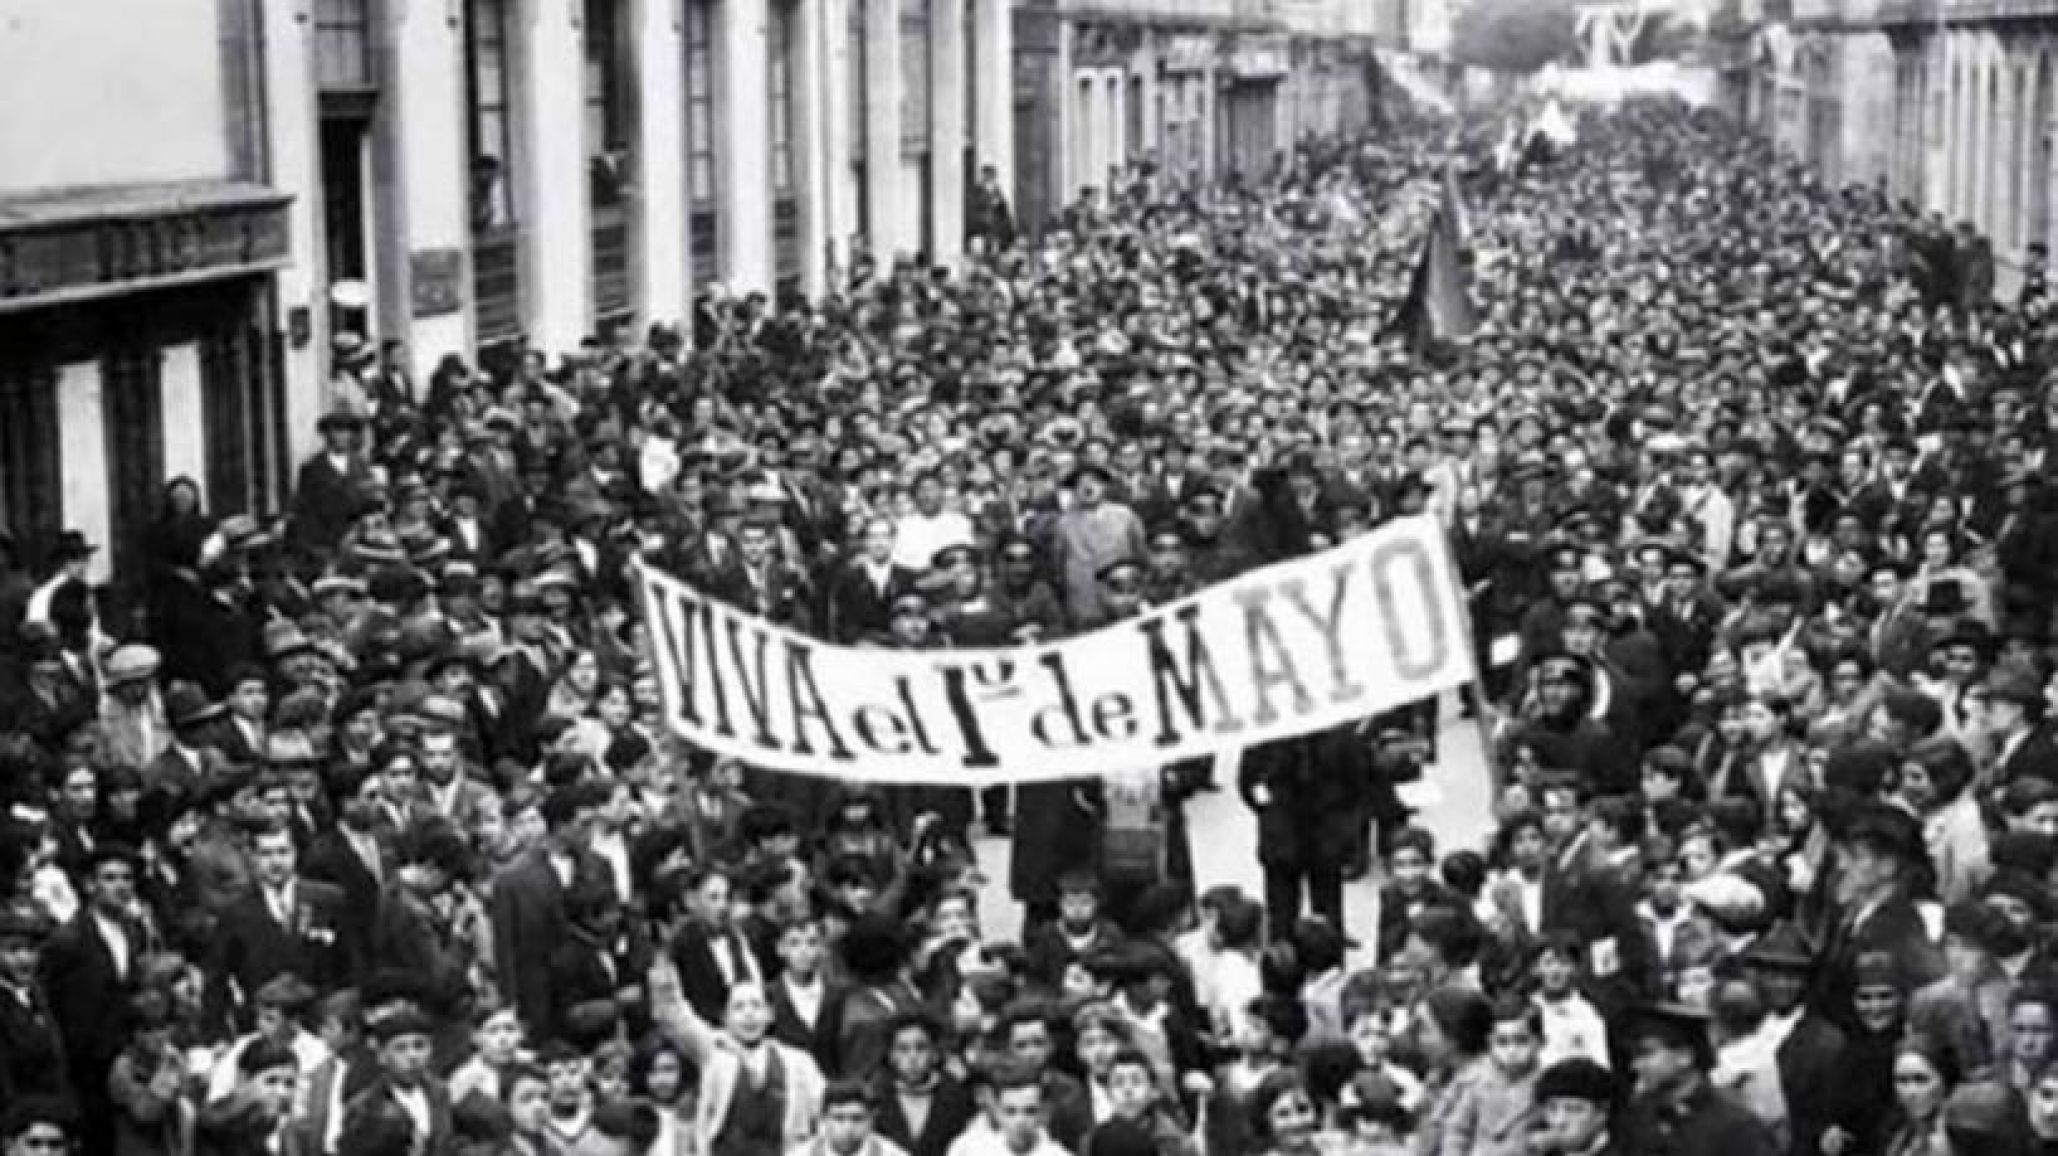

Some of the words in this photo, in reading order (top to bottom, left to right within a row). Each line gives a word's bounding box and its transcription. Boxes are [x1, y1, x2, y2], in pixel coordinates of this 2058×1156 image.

[651, 584, 856, 761] VIVA
[854, 675, 942, 754] el
[1030, 651, 1138, 749] de
[1137, 537, 1448, 748] MAYO
